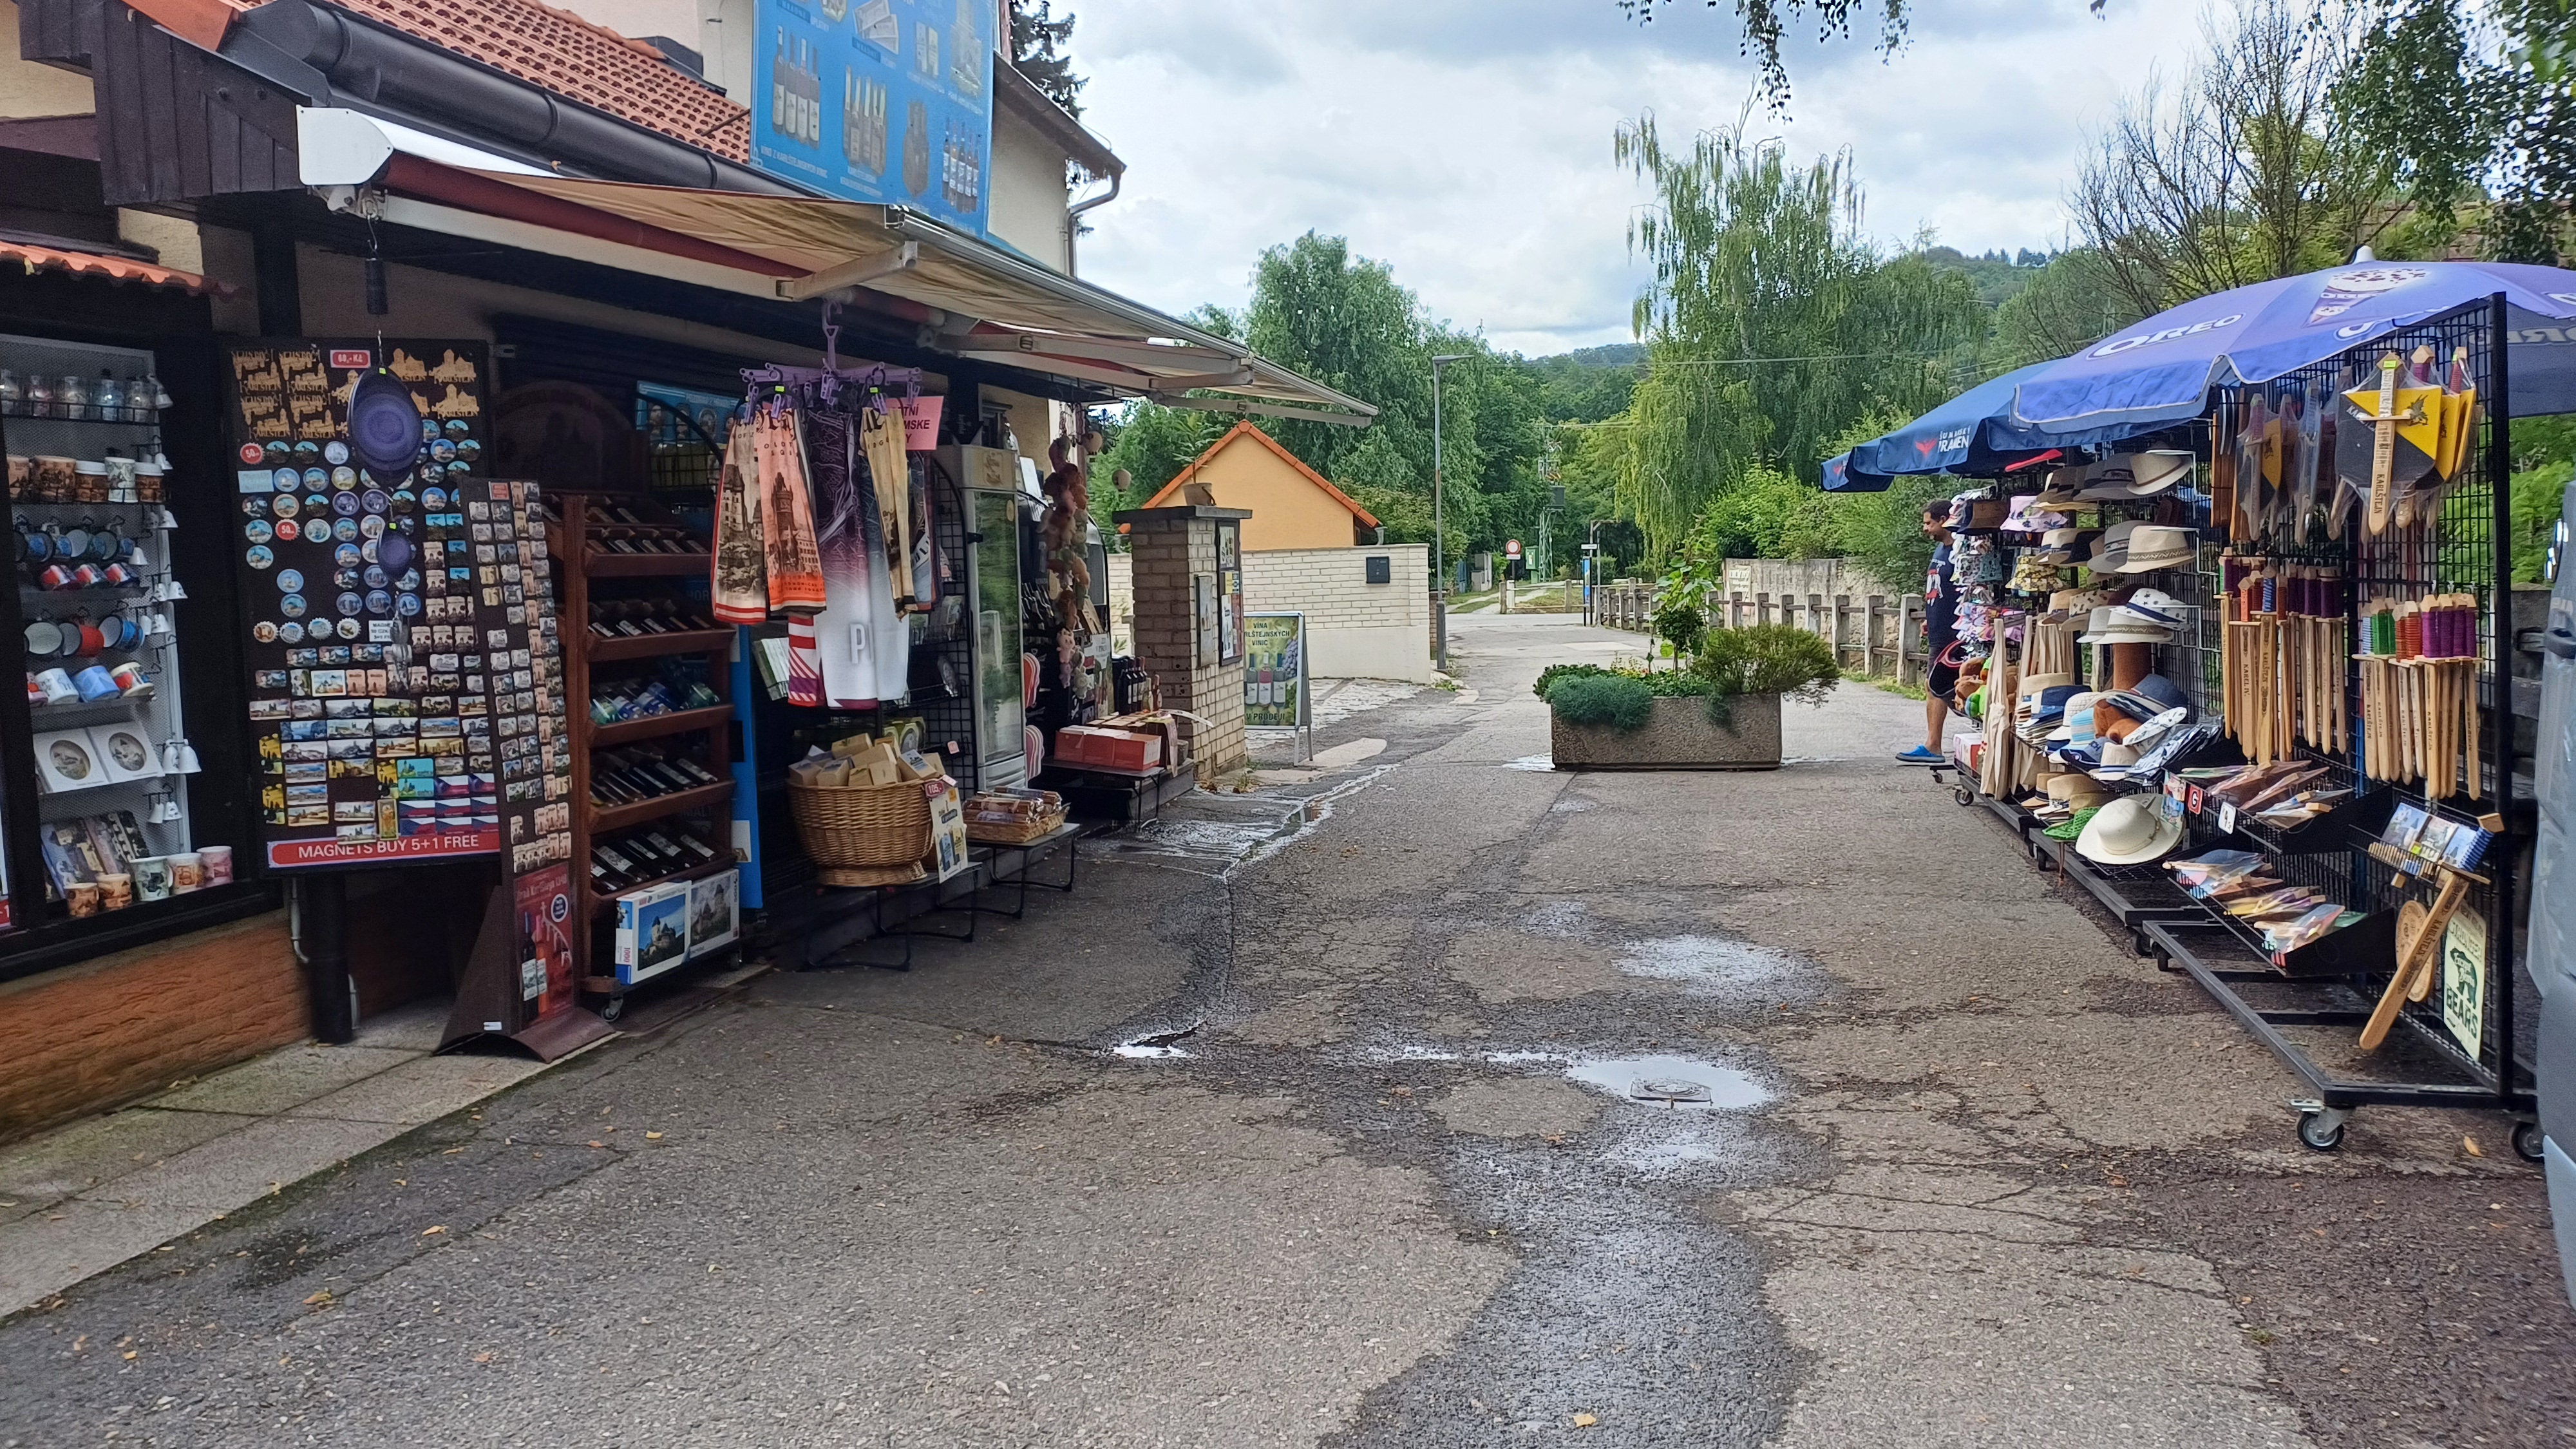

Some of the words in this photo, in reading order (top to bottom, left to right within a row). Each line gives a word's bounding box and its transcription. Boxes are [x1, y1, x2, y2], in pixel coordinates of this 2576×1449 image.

[2091, 314, 2244, 356] OREO
[903, 404, 919, 416] TNÍ
[904, 420, 931, 430] MSKE
[2374, 473, 2387, 514] KARLŠTEJN
[298, 844, 373, 858] MAGNETS
[377, 839, 407, 853] BUY
[412, 838, 439, 851] 5+1
[444, 835, 479, 849] FREE
[2446, 983, 2478, 1039] BEARS
